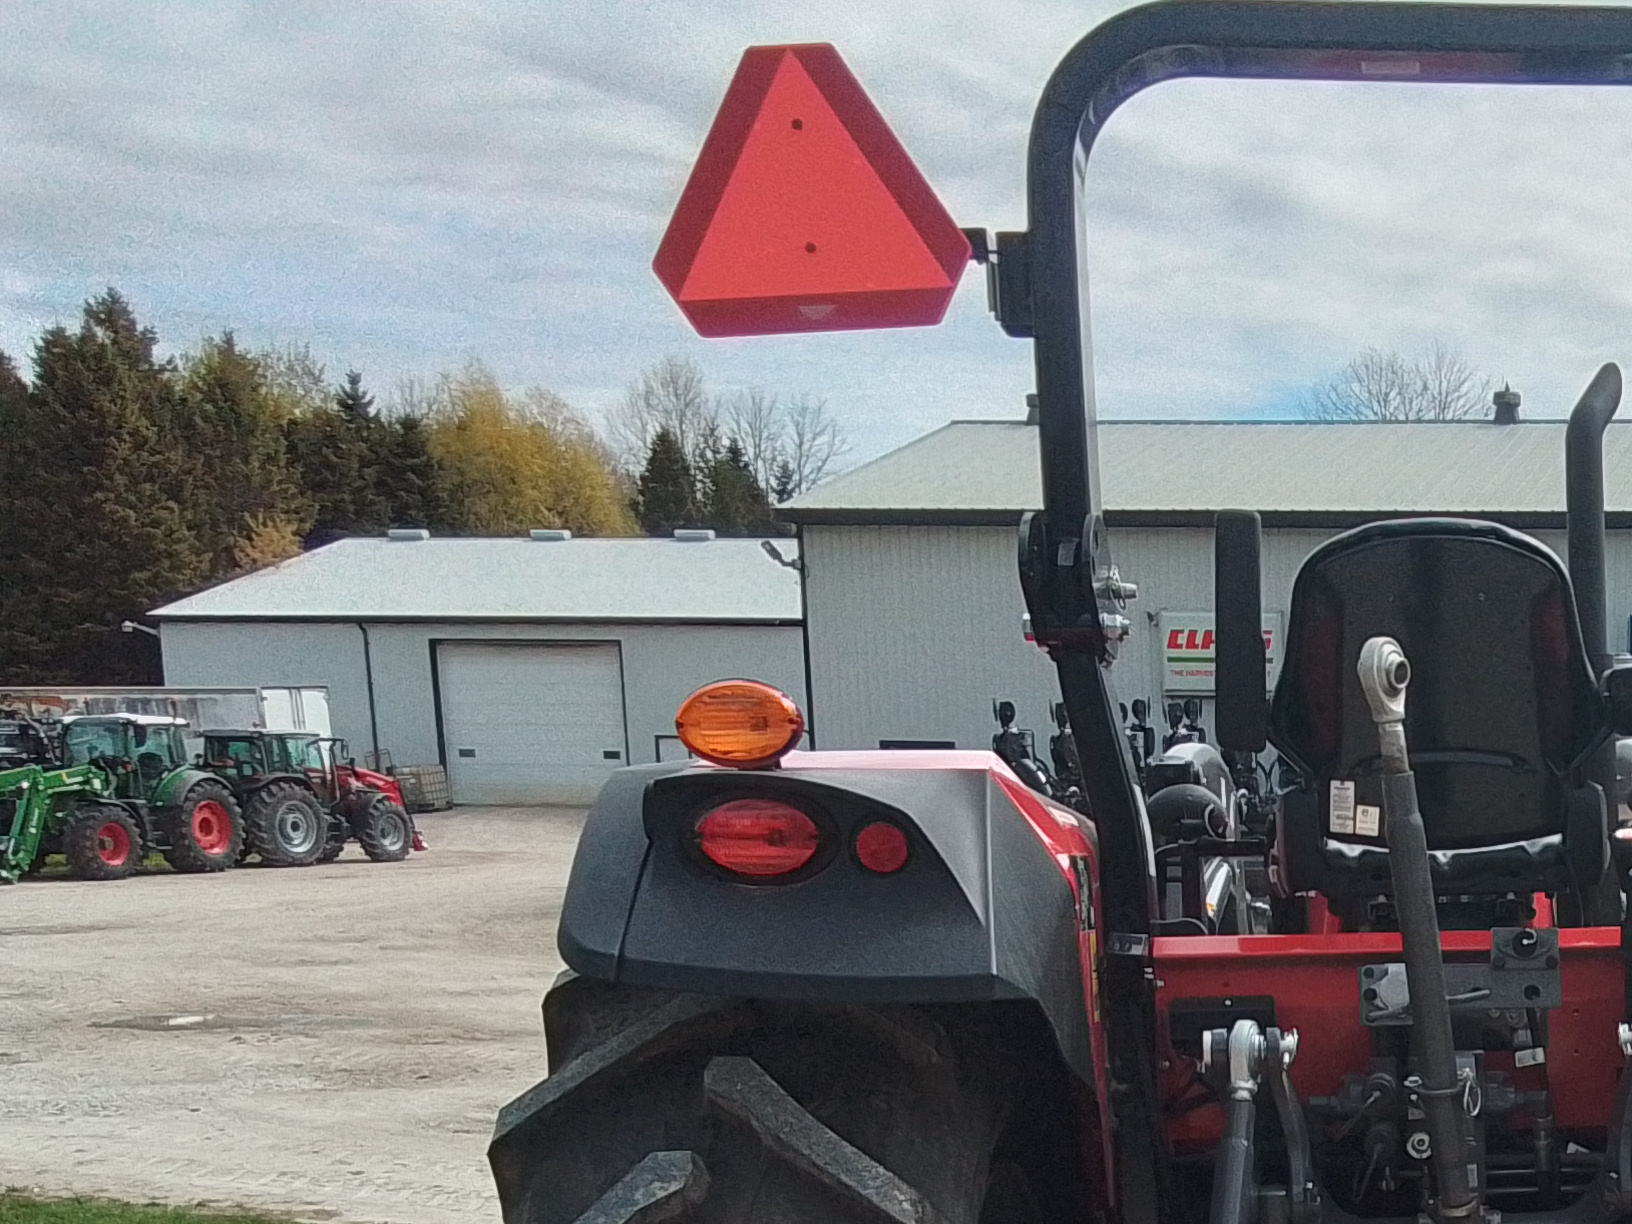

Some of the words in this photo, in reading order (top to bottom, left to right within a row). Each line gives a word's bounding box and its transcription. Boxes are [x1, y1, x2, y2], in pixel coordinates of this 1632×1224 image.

[1167, 629, 1273, 650] CLAS
[1170, 669, 1184, 677] THE
[1185, 669, 1214, 677] HARVES
